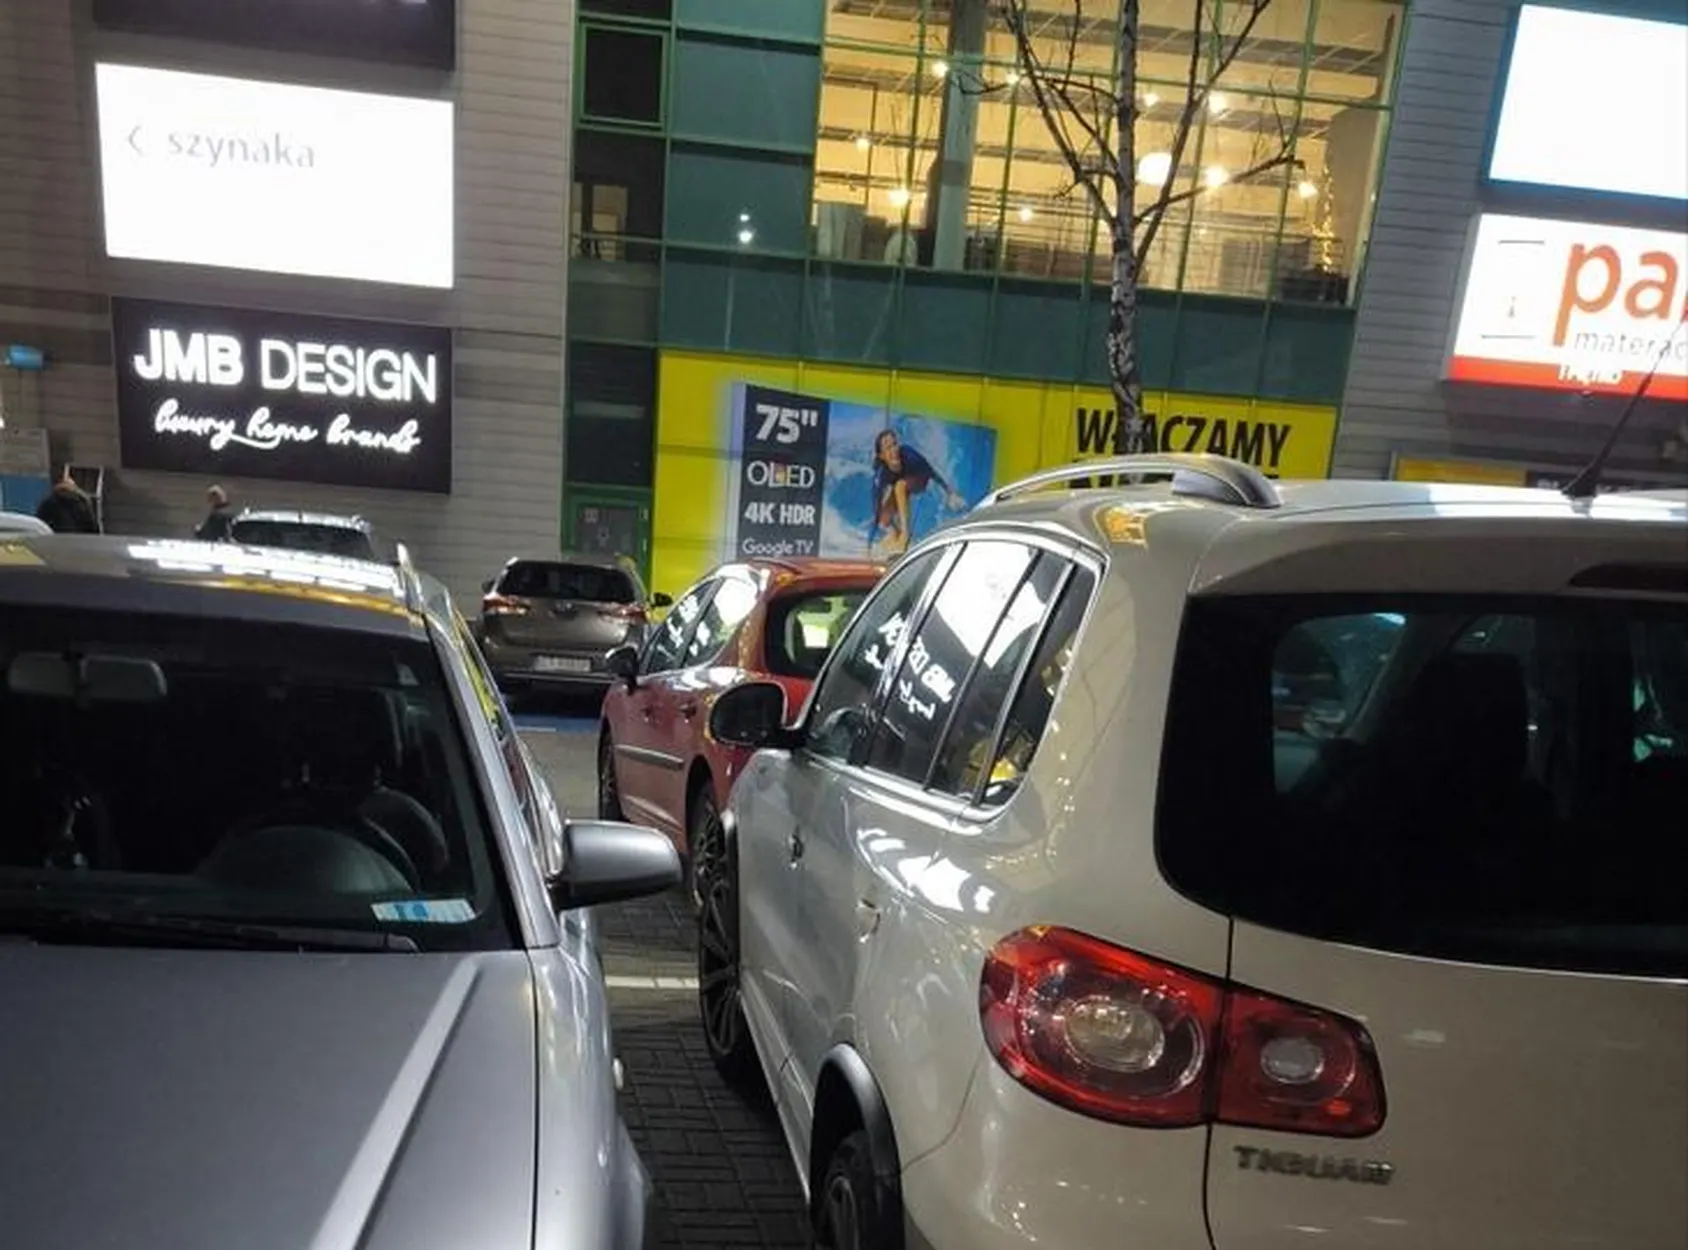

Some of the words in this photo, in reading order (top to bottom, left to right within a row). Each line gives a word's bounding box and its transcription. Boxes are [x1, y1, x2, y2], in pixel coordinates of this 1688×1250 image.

[168, 131, 316, 167] szynaka
[1553, 243, 1688, 348] pa
[134, 328, 245, 386] JMB
[260, 339, 437, 404] DESIGN
[154, 398, 237, 450] luxury
[246, 406, 319, 445] home
[326, 413, 422, 453] brands
[756, 403, 819, 444] 75"
[1077, 407, 1292, 468] WCZAMY
[746, 460, 816, 489] OLED
[744, 502, 775, 524] 4K
[780, 503, 816, 526] HDR
[742, 537, 795, 557] Google
[795, 539, 815, 555] TV
